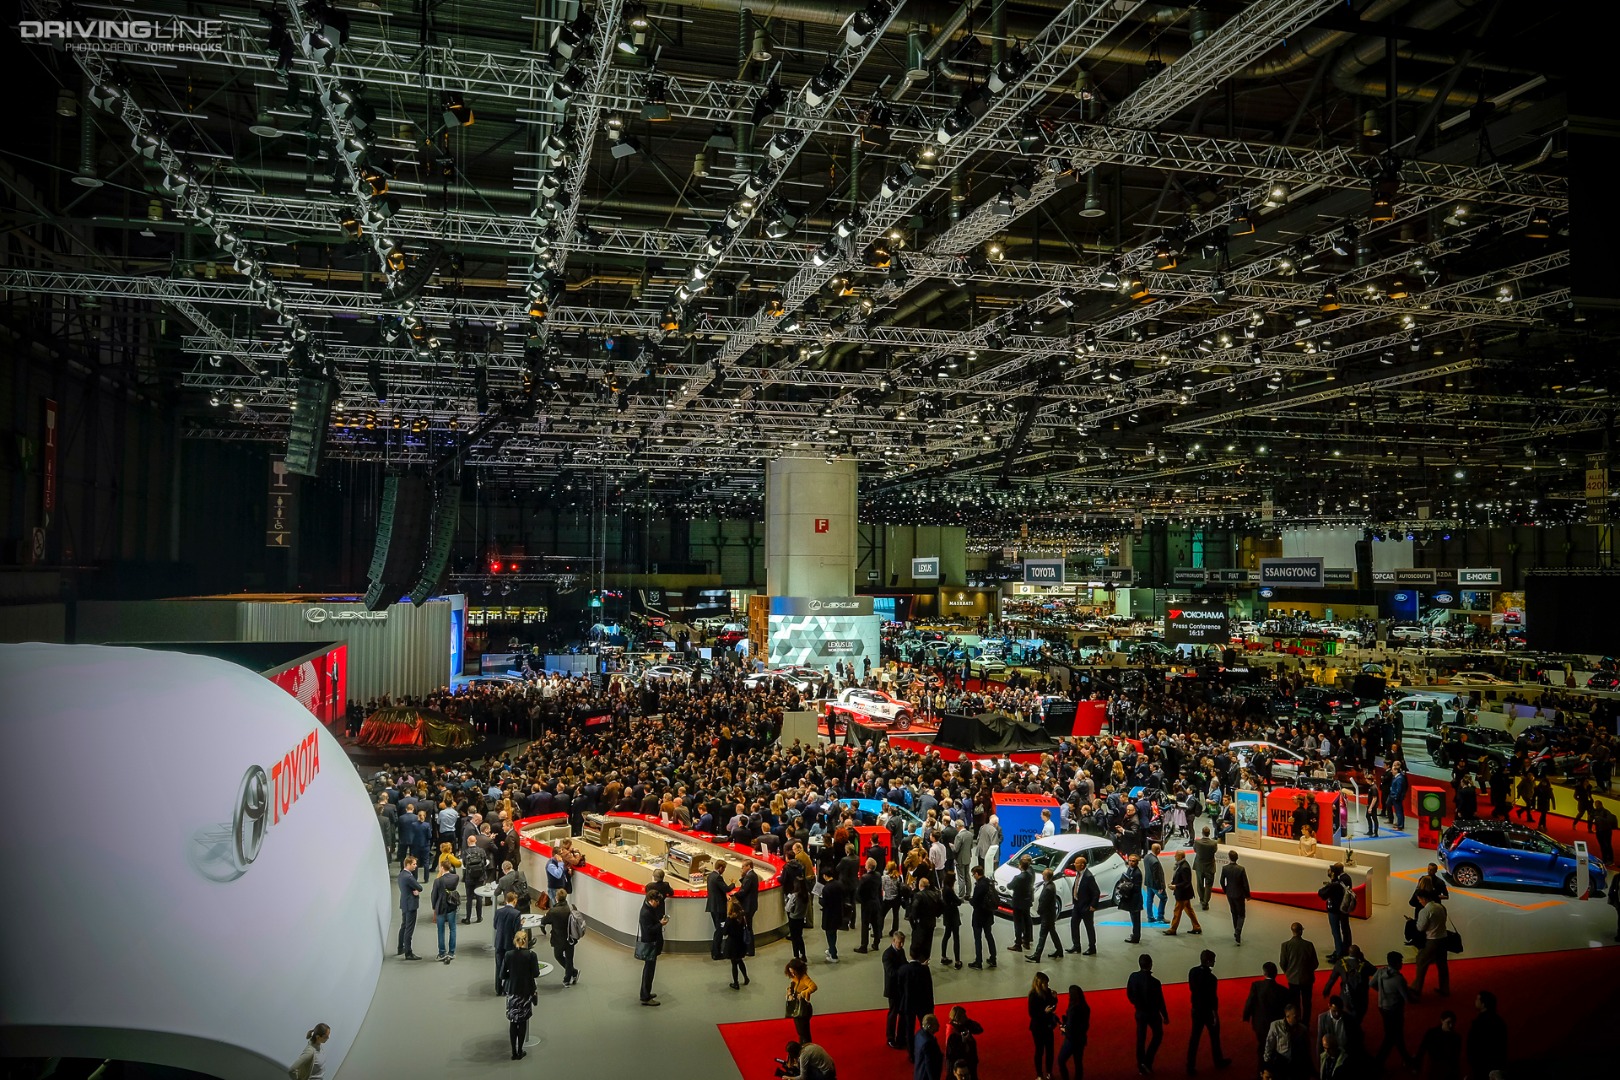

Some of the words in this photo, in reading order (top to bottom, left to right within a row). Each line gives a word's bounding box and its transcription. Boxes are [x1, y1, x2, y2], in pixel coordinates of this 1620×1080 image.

[1594, 462, 1600, 470] 4
[1587, 481, 1608, 490] 4200
[818, 520, 826, 530] F
[918, 564, 932, 572] LEXUS
[1031, 567, 1056, 578] TOYOTA
[1264, 567, 1317, 578] SSANGYONG
[1111, 571, 1122, 579] RUF
[1436, 570, 1453, 578] AZDA
[1466, 572, 1492, 580] E-MOKE
[329, 611, 389, 620] LEXUS
[1181, 610, 1224, 620] YOKOHAMA
[271, 727, 320, 826] TOYOTA
[1011, 835, 1032, 847] JUST
